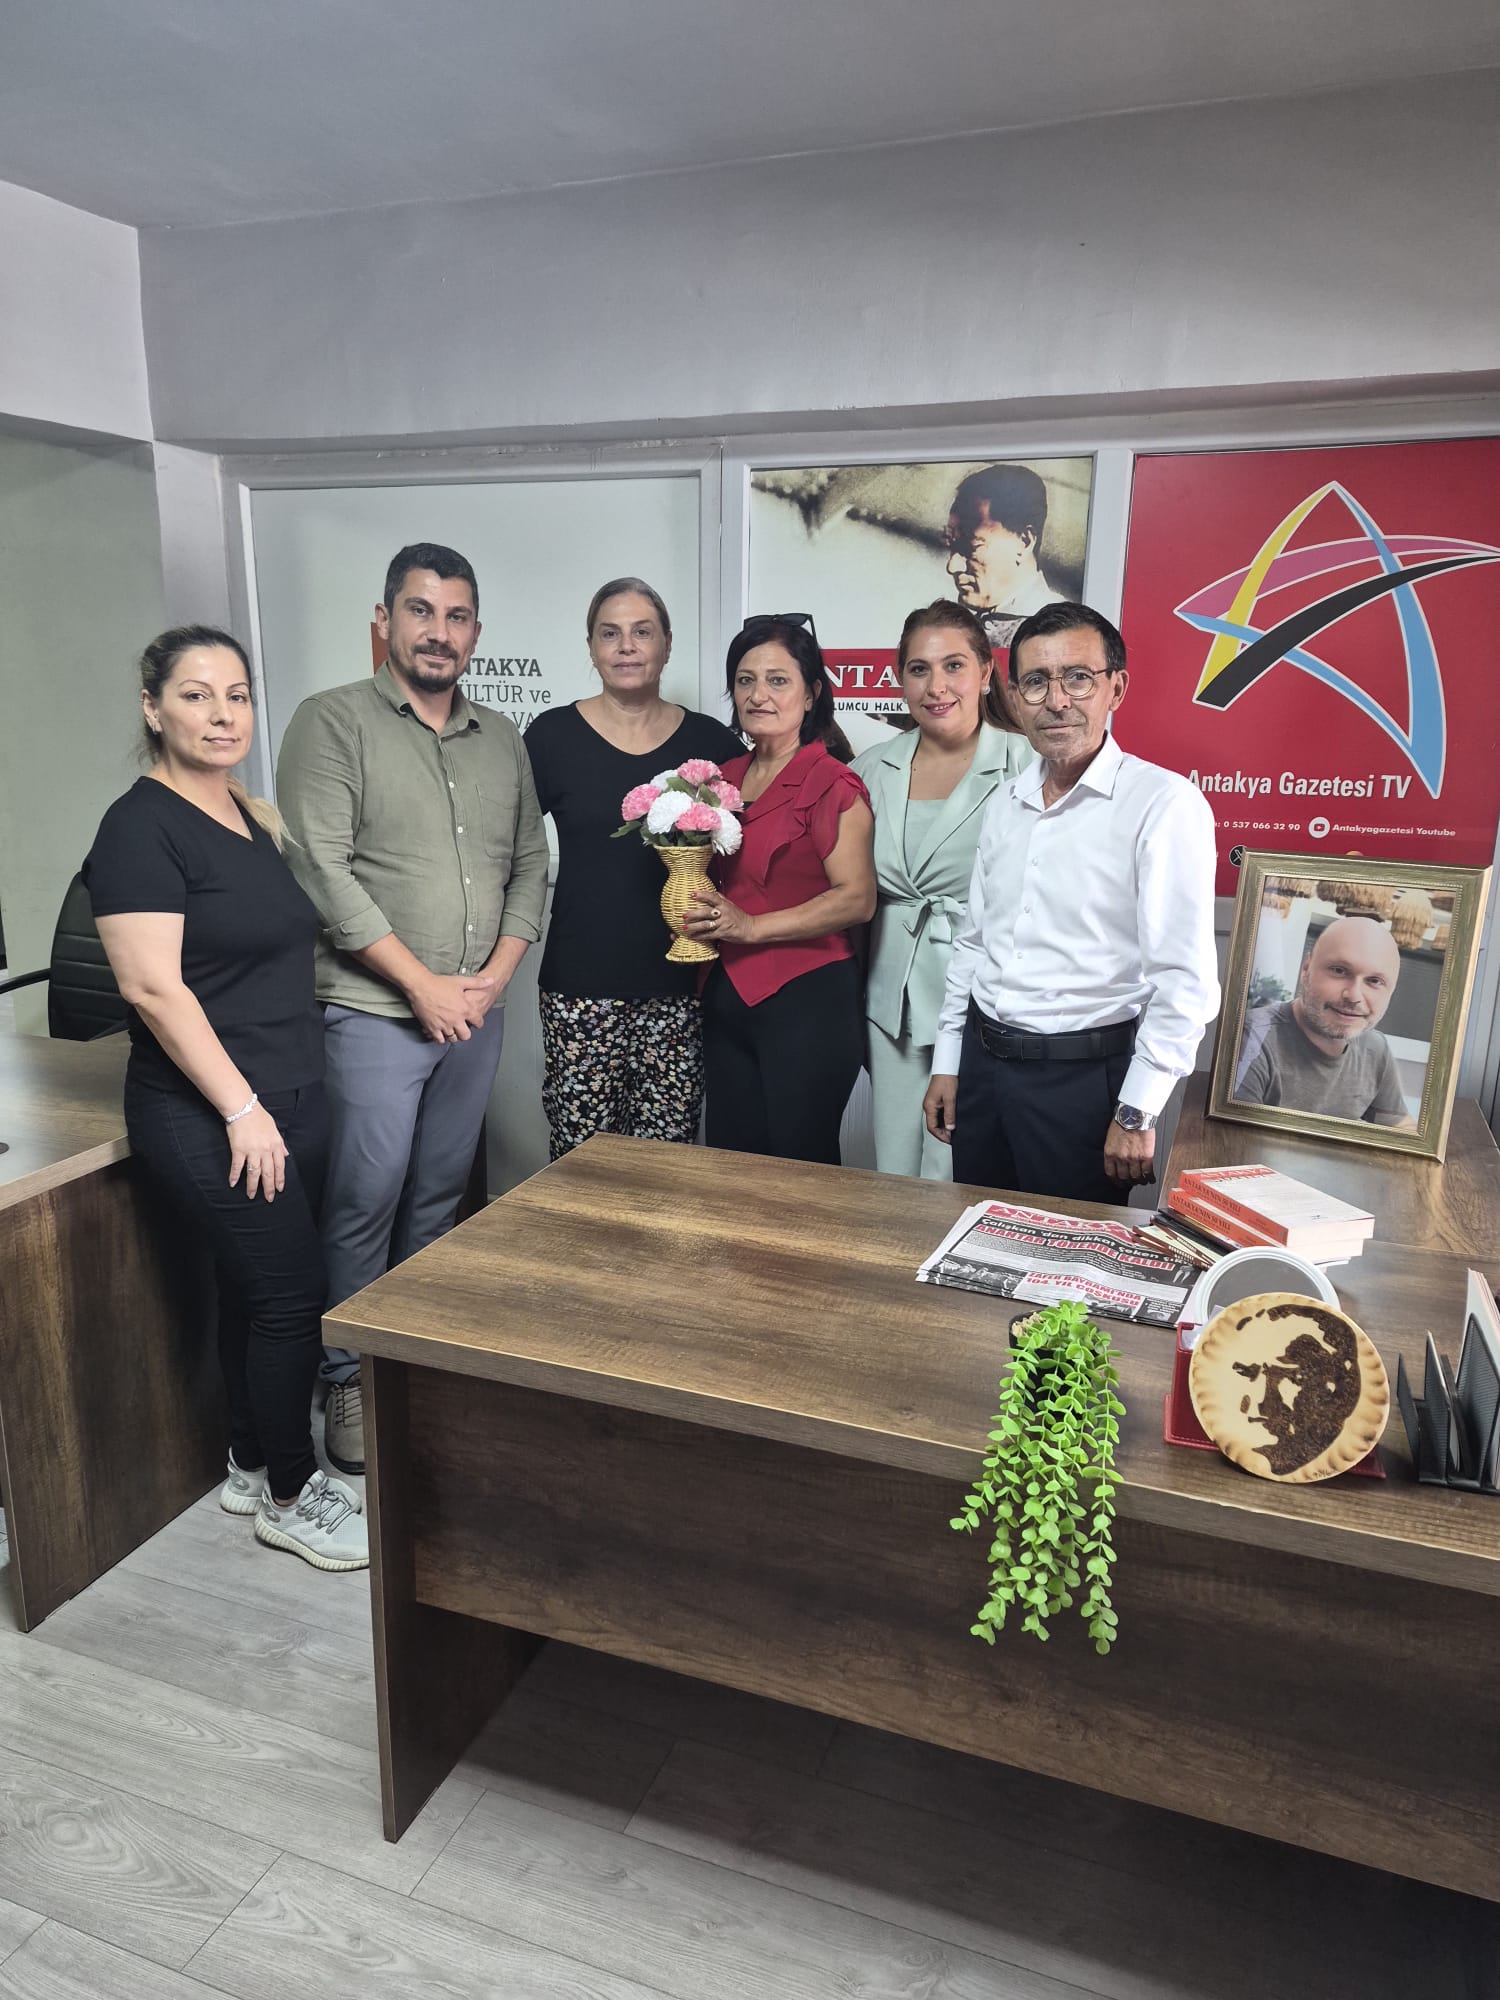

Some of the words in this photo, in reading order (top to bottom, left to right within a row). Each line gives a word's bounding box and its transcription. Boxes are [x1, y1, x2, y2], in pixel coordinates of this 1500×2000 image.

[824, 665, 904, 688] NTA
[457, 679, 523, 703] ÜLTÜR
[529, 690, 551, 703] ve
[874, 702, 903, 711] HALK
[1187, 769, 1272, 799] Antakya
[1279, 771, 1375, 798] Gazetesi
[1381, 774, 1412, 799] TV
[1232, 821, 1251, 829] 537
[1252, 822, 1271, 830] 066
[1273, 823, 1286, 831] 32
[1288, 823, 1301, 831] 90
[1332, 823, 1414, 835] Antakyagazetesi
[1416, 827, 1456, 837] Youtube
[975, 1224, 1046, 1245] ANAHTAR
[1072, 1233, 1116, 1247] dikkat
[1028, 1271, 1061, 1280] ZAFER
